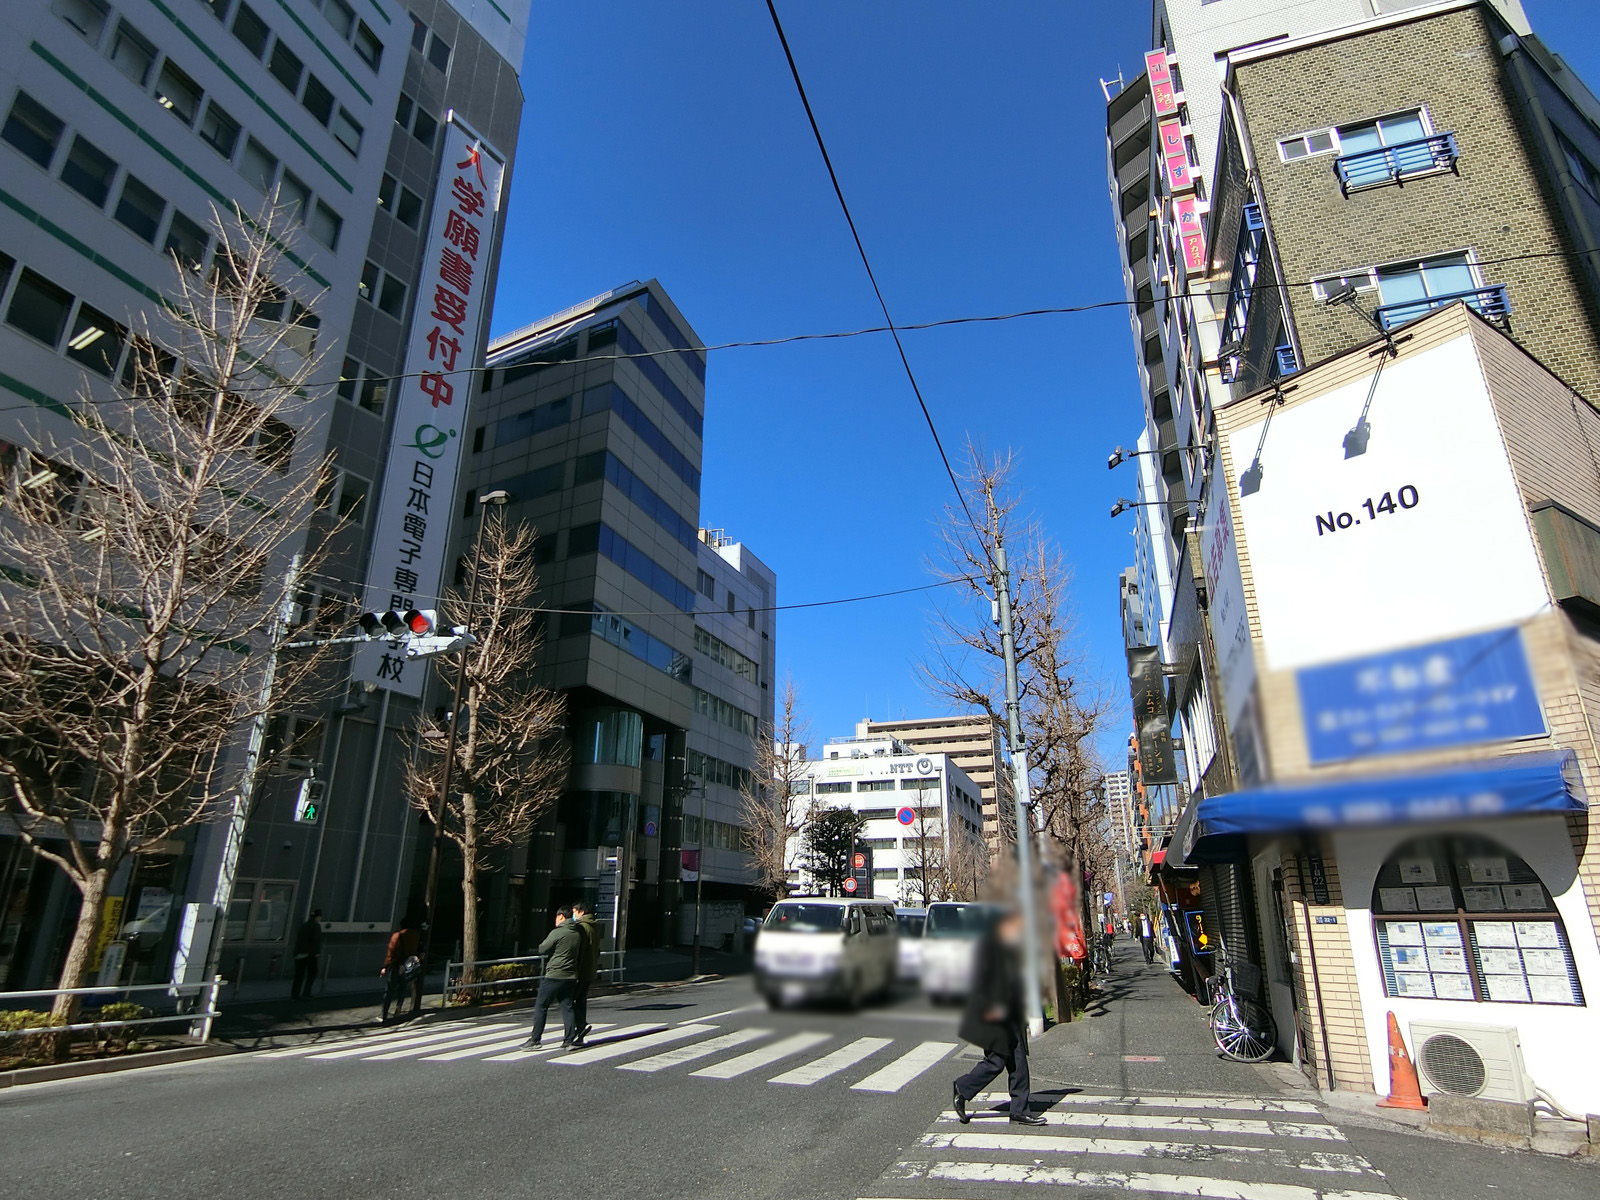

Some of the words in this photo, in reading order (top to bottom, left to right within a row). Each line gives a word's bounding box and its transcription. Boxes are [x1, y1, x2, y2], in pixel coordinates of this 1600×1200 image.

[419, 144, 487, 409] 入学願書受付中
[1315, 484, 1419, 536] No.140
[889, 763, 914, 774] NTT
[1313, 876, 1325, 885] 22
